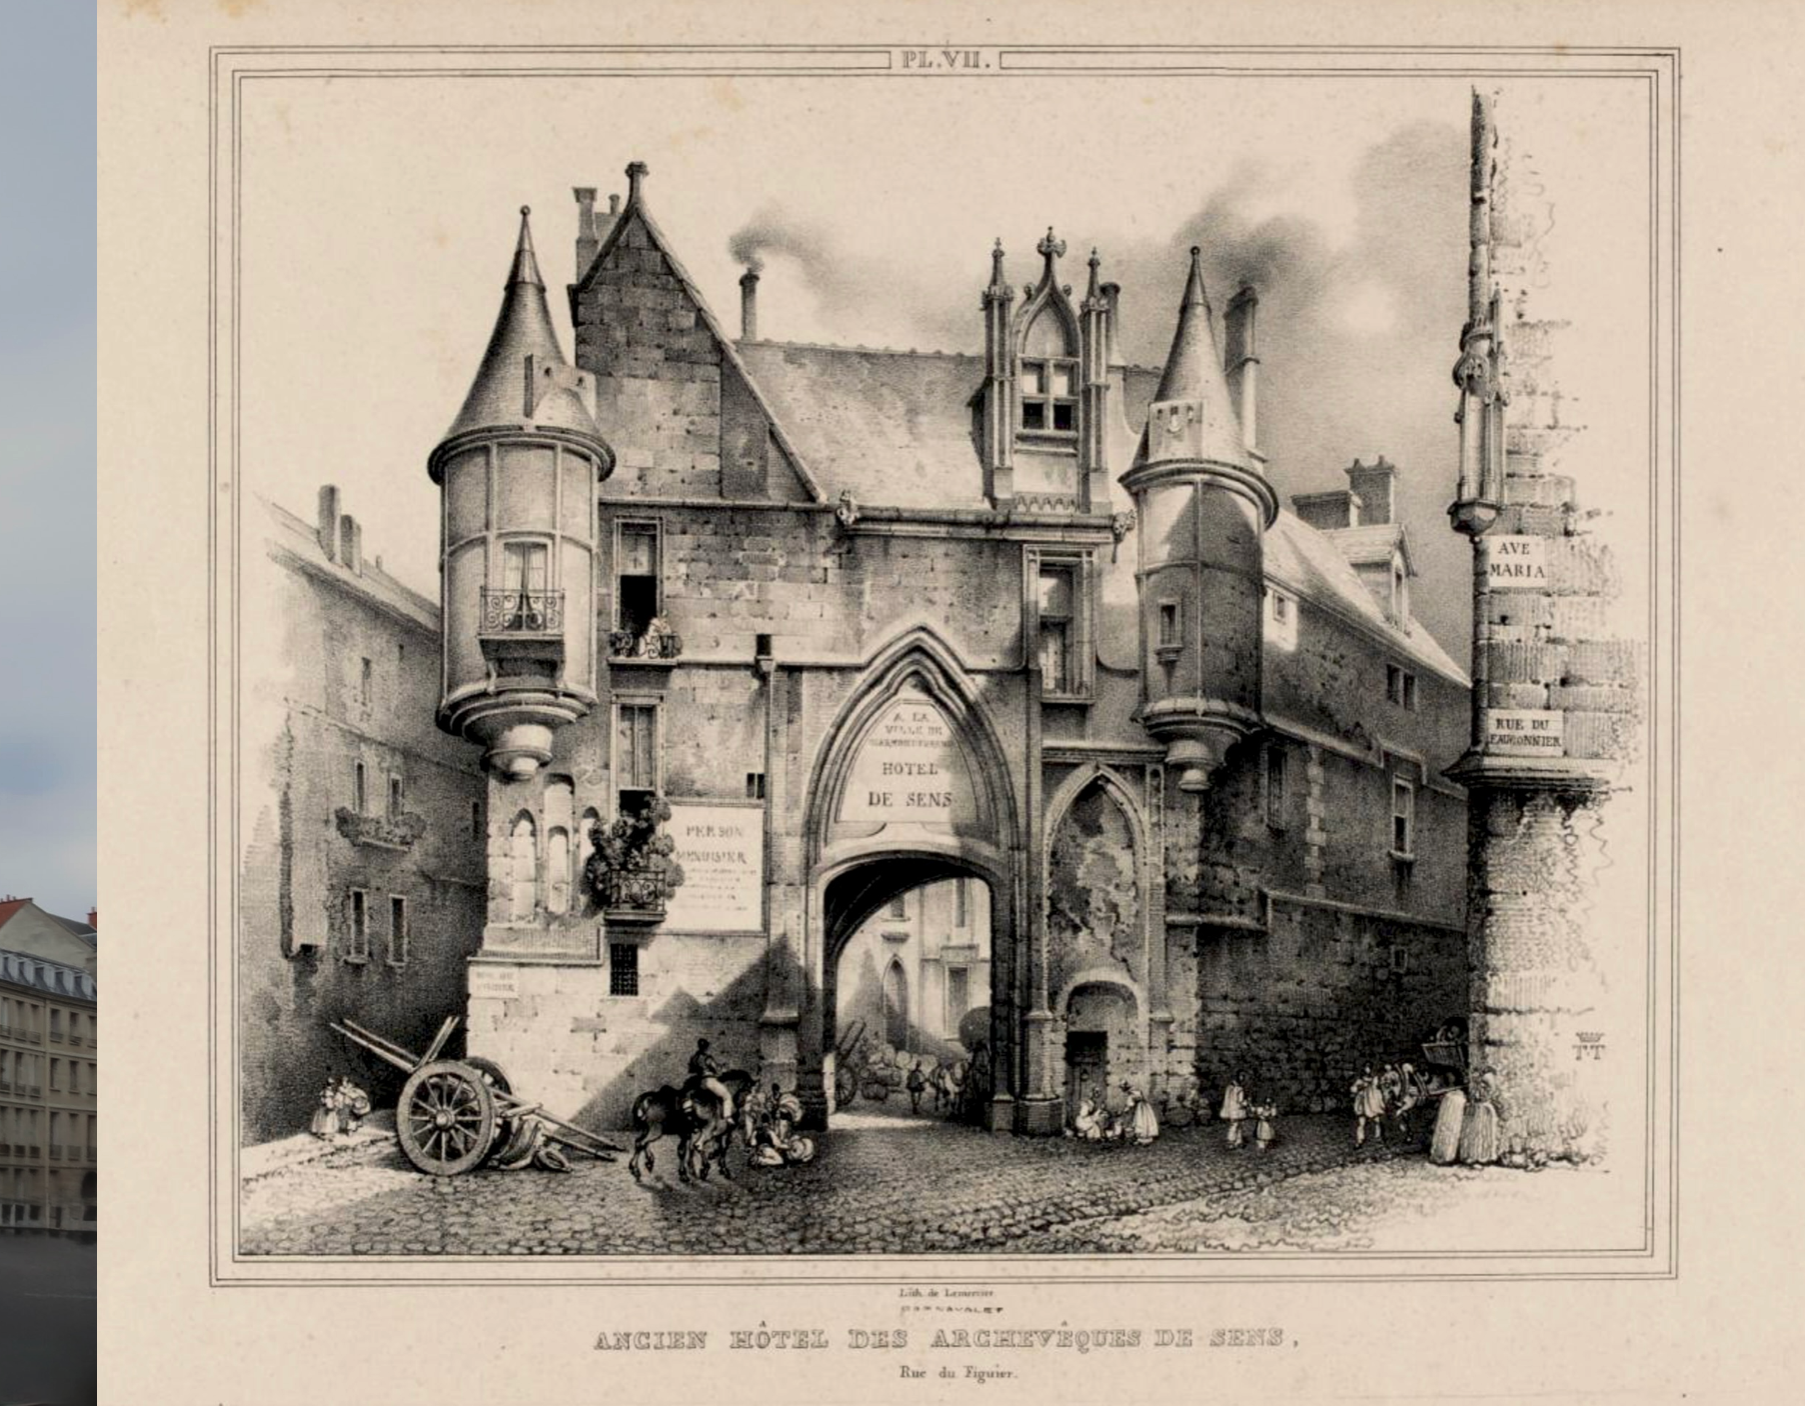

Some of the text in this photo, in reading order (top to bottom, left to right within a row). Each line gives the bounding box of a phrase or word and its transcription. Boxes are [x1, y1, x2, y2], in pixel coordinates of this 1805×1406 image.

[1497, 542, 1530, 555] AVE
[1490, 563, 1545, 579] MARIA
[1496, 717, 1550, 731] RUE DU
[882, 762, 938, 776] HOTEL
[868, 791, 953, 808] DE SENS
[595, 1330, 708, 1350] ANCIEN
[730, 1320, 829, 1350] HÔTEL
[848, 1329, 908, 1349] DES
[931, 1320, 1142, 1354] ARCHEVÊQUES
[1154, 1328, 1193, 1347] DE
[899, 1364, 927, 1379] Rue
[938, 1365, 955, 1379] du
